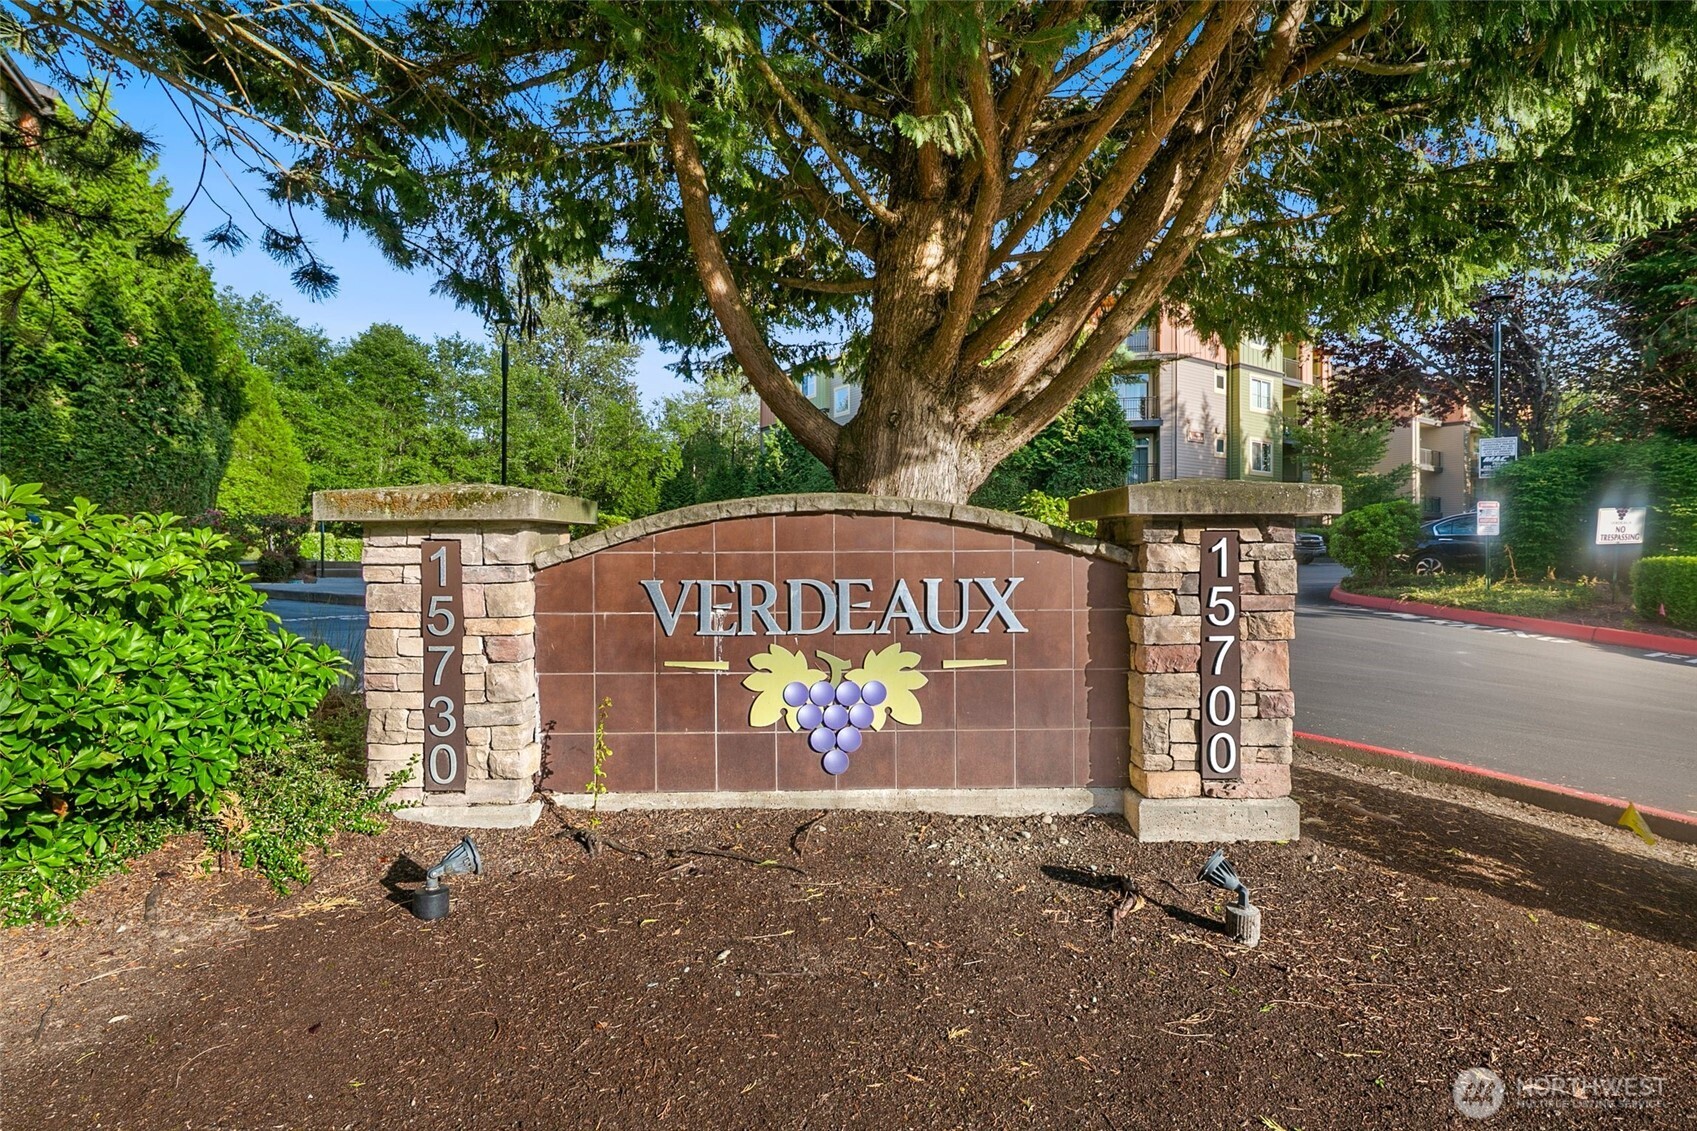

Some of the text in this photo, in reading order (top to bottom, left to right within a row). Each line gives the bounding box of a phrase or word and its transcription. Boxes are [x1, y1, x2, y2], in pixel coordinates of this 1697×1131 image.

[1600, 533, 1640, 542] TRESPASSING
[1615, 525, 1627, 534] NO
[640, 577, 1029, 637] VERDEAUX
[427, 546, 458, 785] 15730
[1206, 537, 1237, 774] 15700
